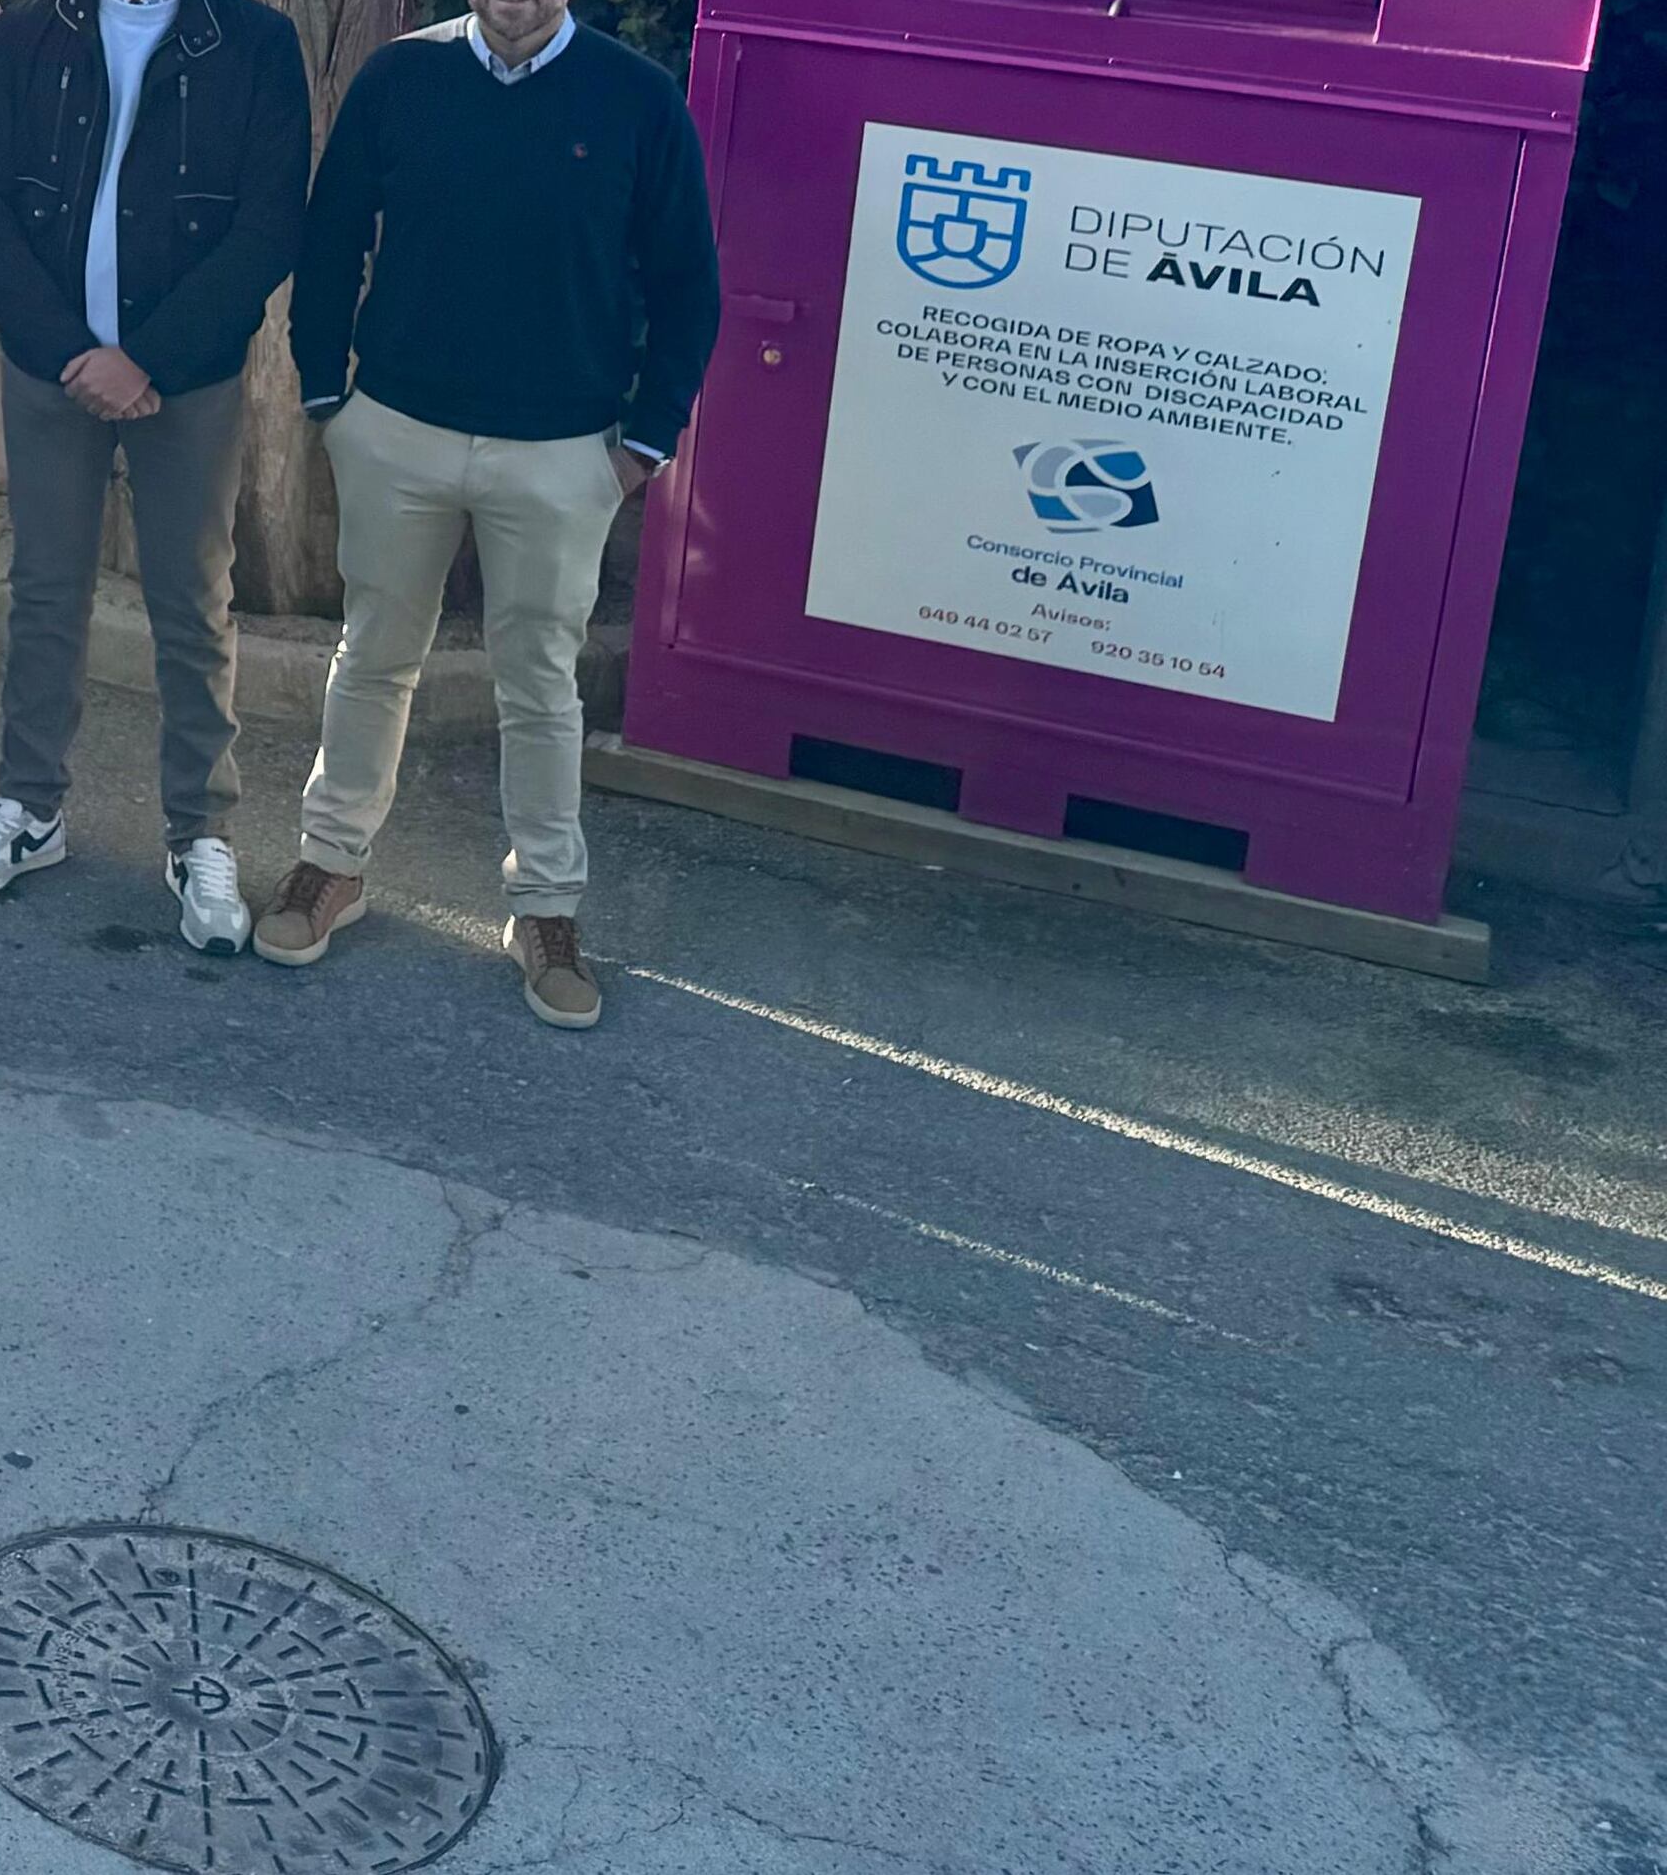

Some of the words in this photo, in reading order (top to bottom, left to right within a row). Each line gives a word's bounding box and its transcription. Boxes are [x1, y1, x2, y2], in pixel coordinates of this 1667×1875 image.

[1065, 242, 1132, 278] DE
[1145, 251, 1321, 307] ÁVILA
[1070, 205, 1385, 278] DIPUTACIÓN
[875, 319, 1012, 355] COLABORA
[1018, 342, 1052, 362] EN
[1058, 348, 1088, 369] LA
[1094, 354, 1237, 392] INSERCIÓN
[1244, 378, 1369, 415] LABORAL
[922, 305, 1052, 341] RECOGIDA
[1057, 327, 1092, 347] DE
[1097, 333, 1166, 360] ROPA
[1172, 345, 1191, 362] Y
[1194, 349, 1328, 386] CALZADO:
[897, 343, 929, 363] DE
[935, 349, 1071, 386] PERSONAS
[1077, 373, 1133, 397] CON
[1144, 384, 1344, 432] DISCAPACIDAD
[941, 370, 959, 387] Y
[962, 374, 1016, 397] CON
[1022, 385, 1052, 404] EL
[1057, 391, 1144, 420] MEDIO
[1147, 406, 1294, 445] AMBIENTE.
[966, 533, 1074, 568] Consorcio
[1078, 555, 1184, 590] Provincial
[1011, 565, 1048, 588] de
[1055, 570, 1130, 605] Ávila
[963, 614, 991, 632] 44
[994, 620, 1023, 639] 02
[1027, 627, 1054, 645] 57
[1090, 640, 1133, 660] 920
[1137, 649, 1165, 667] 35
[1170, 656, 1194, 673] 10
[1197, 661, 1226, 679] 54
